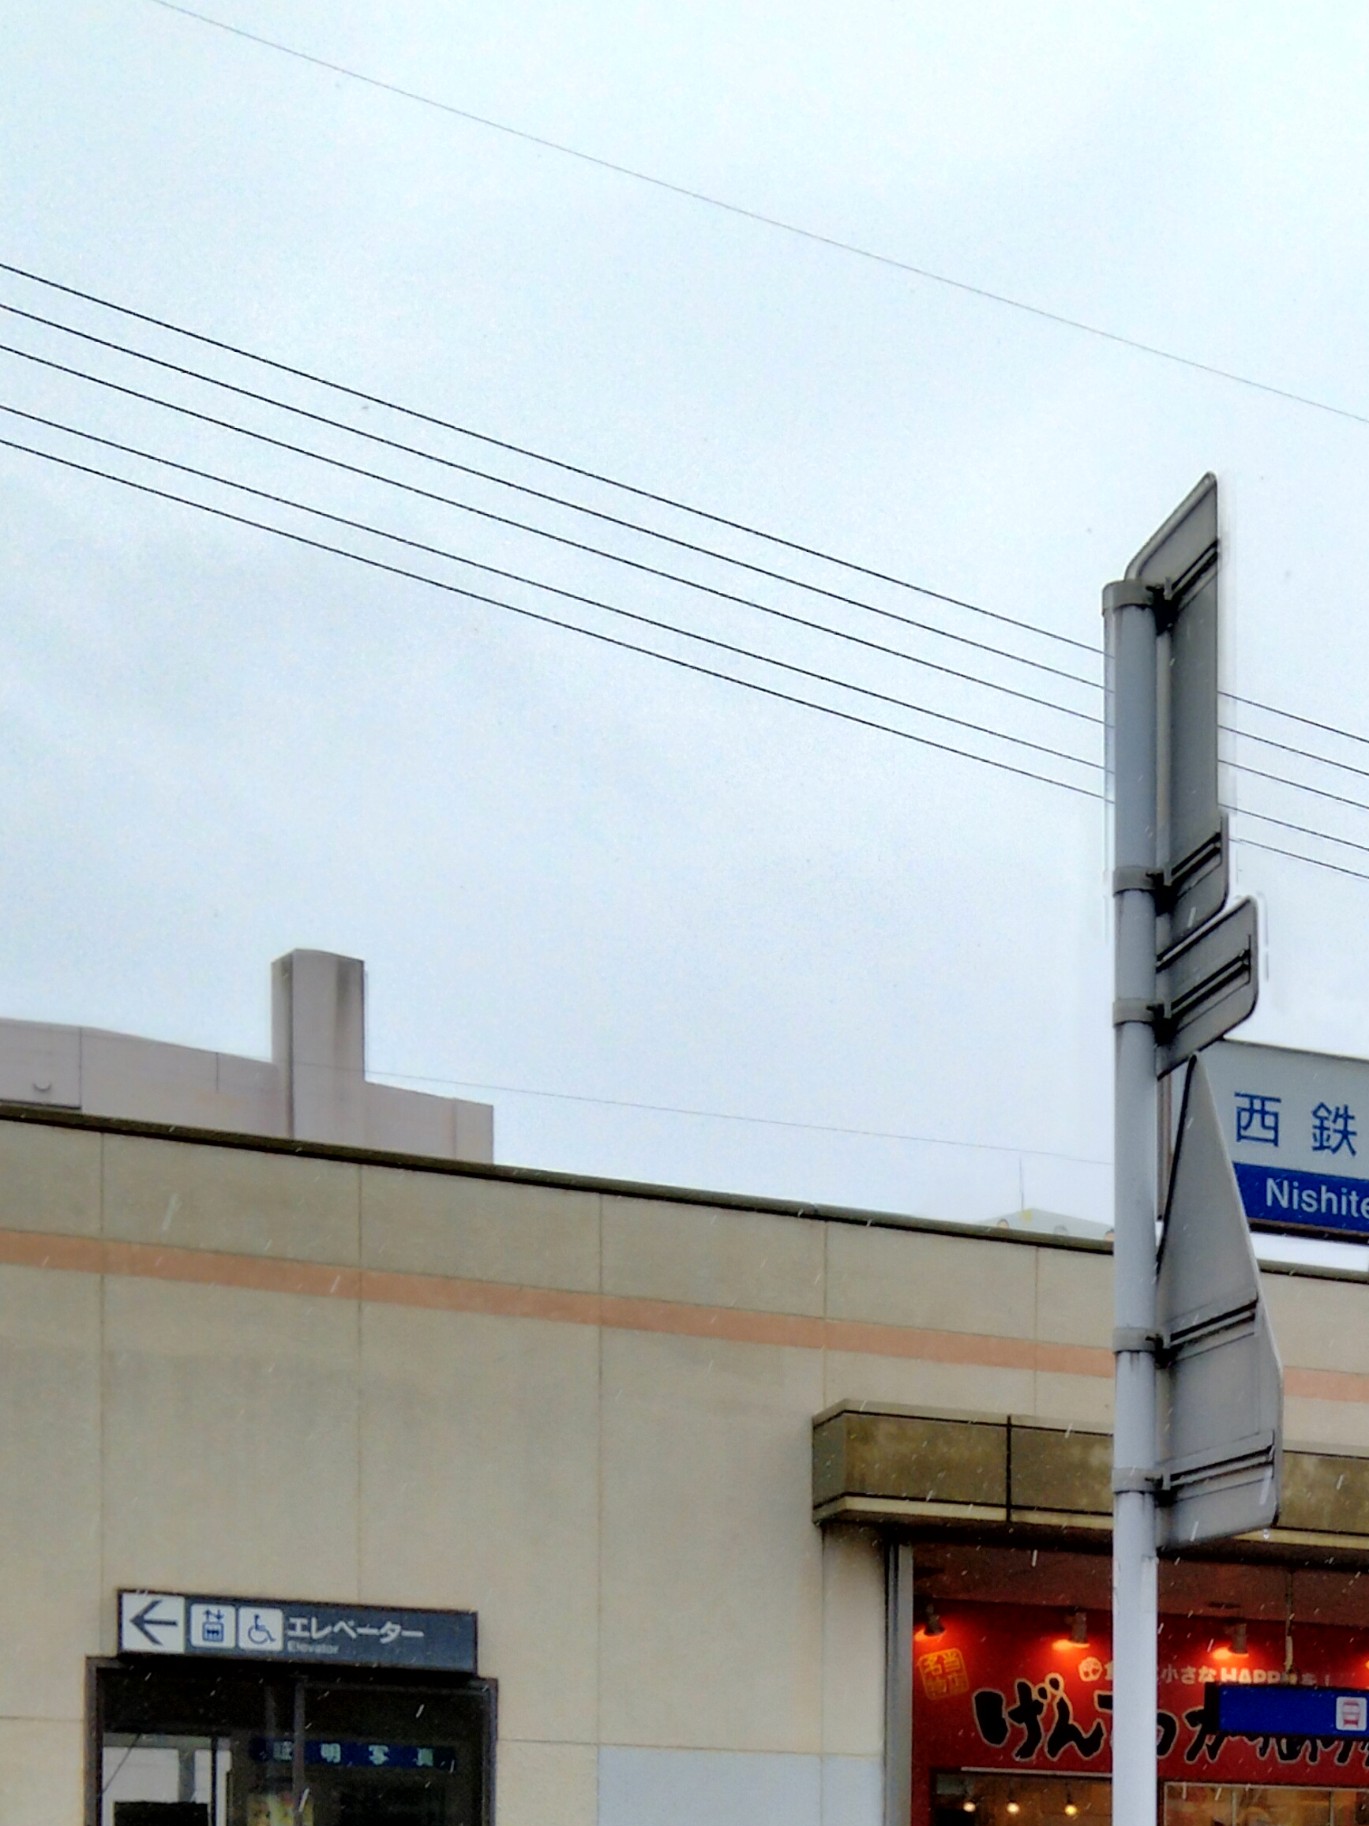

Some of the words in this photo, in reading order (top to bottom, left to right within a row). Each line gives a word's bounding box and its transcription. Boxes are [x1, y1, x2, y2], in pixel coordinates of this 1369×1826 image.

[287, 1617, 425, 1644] エレベーター
